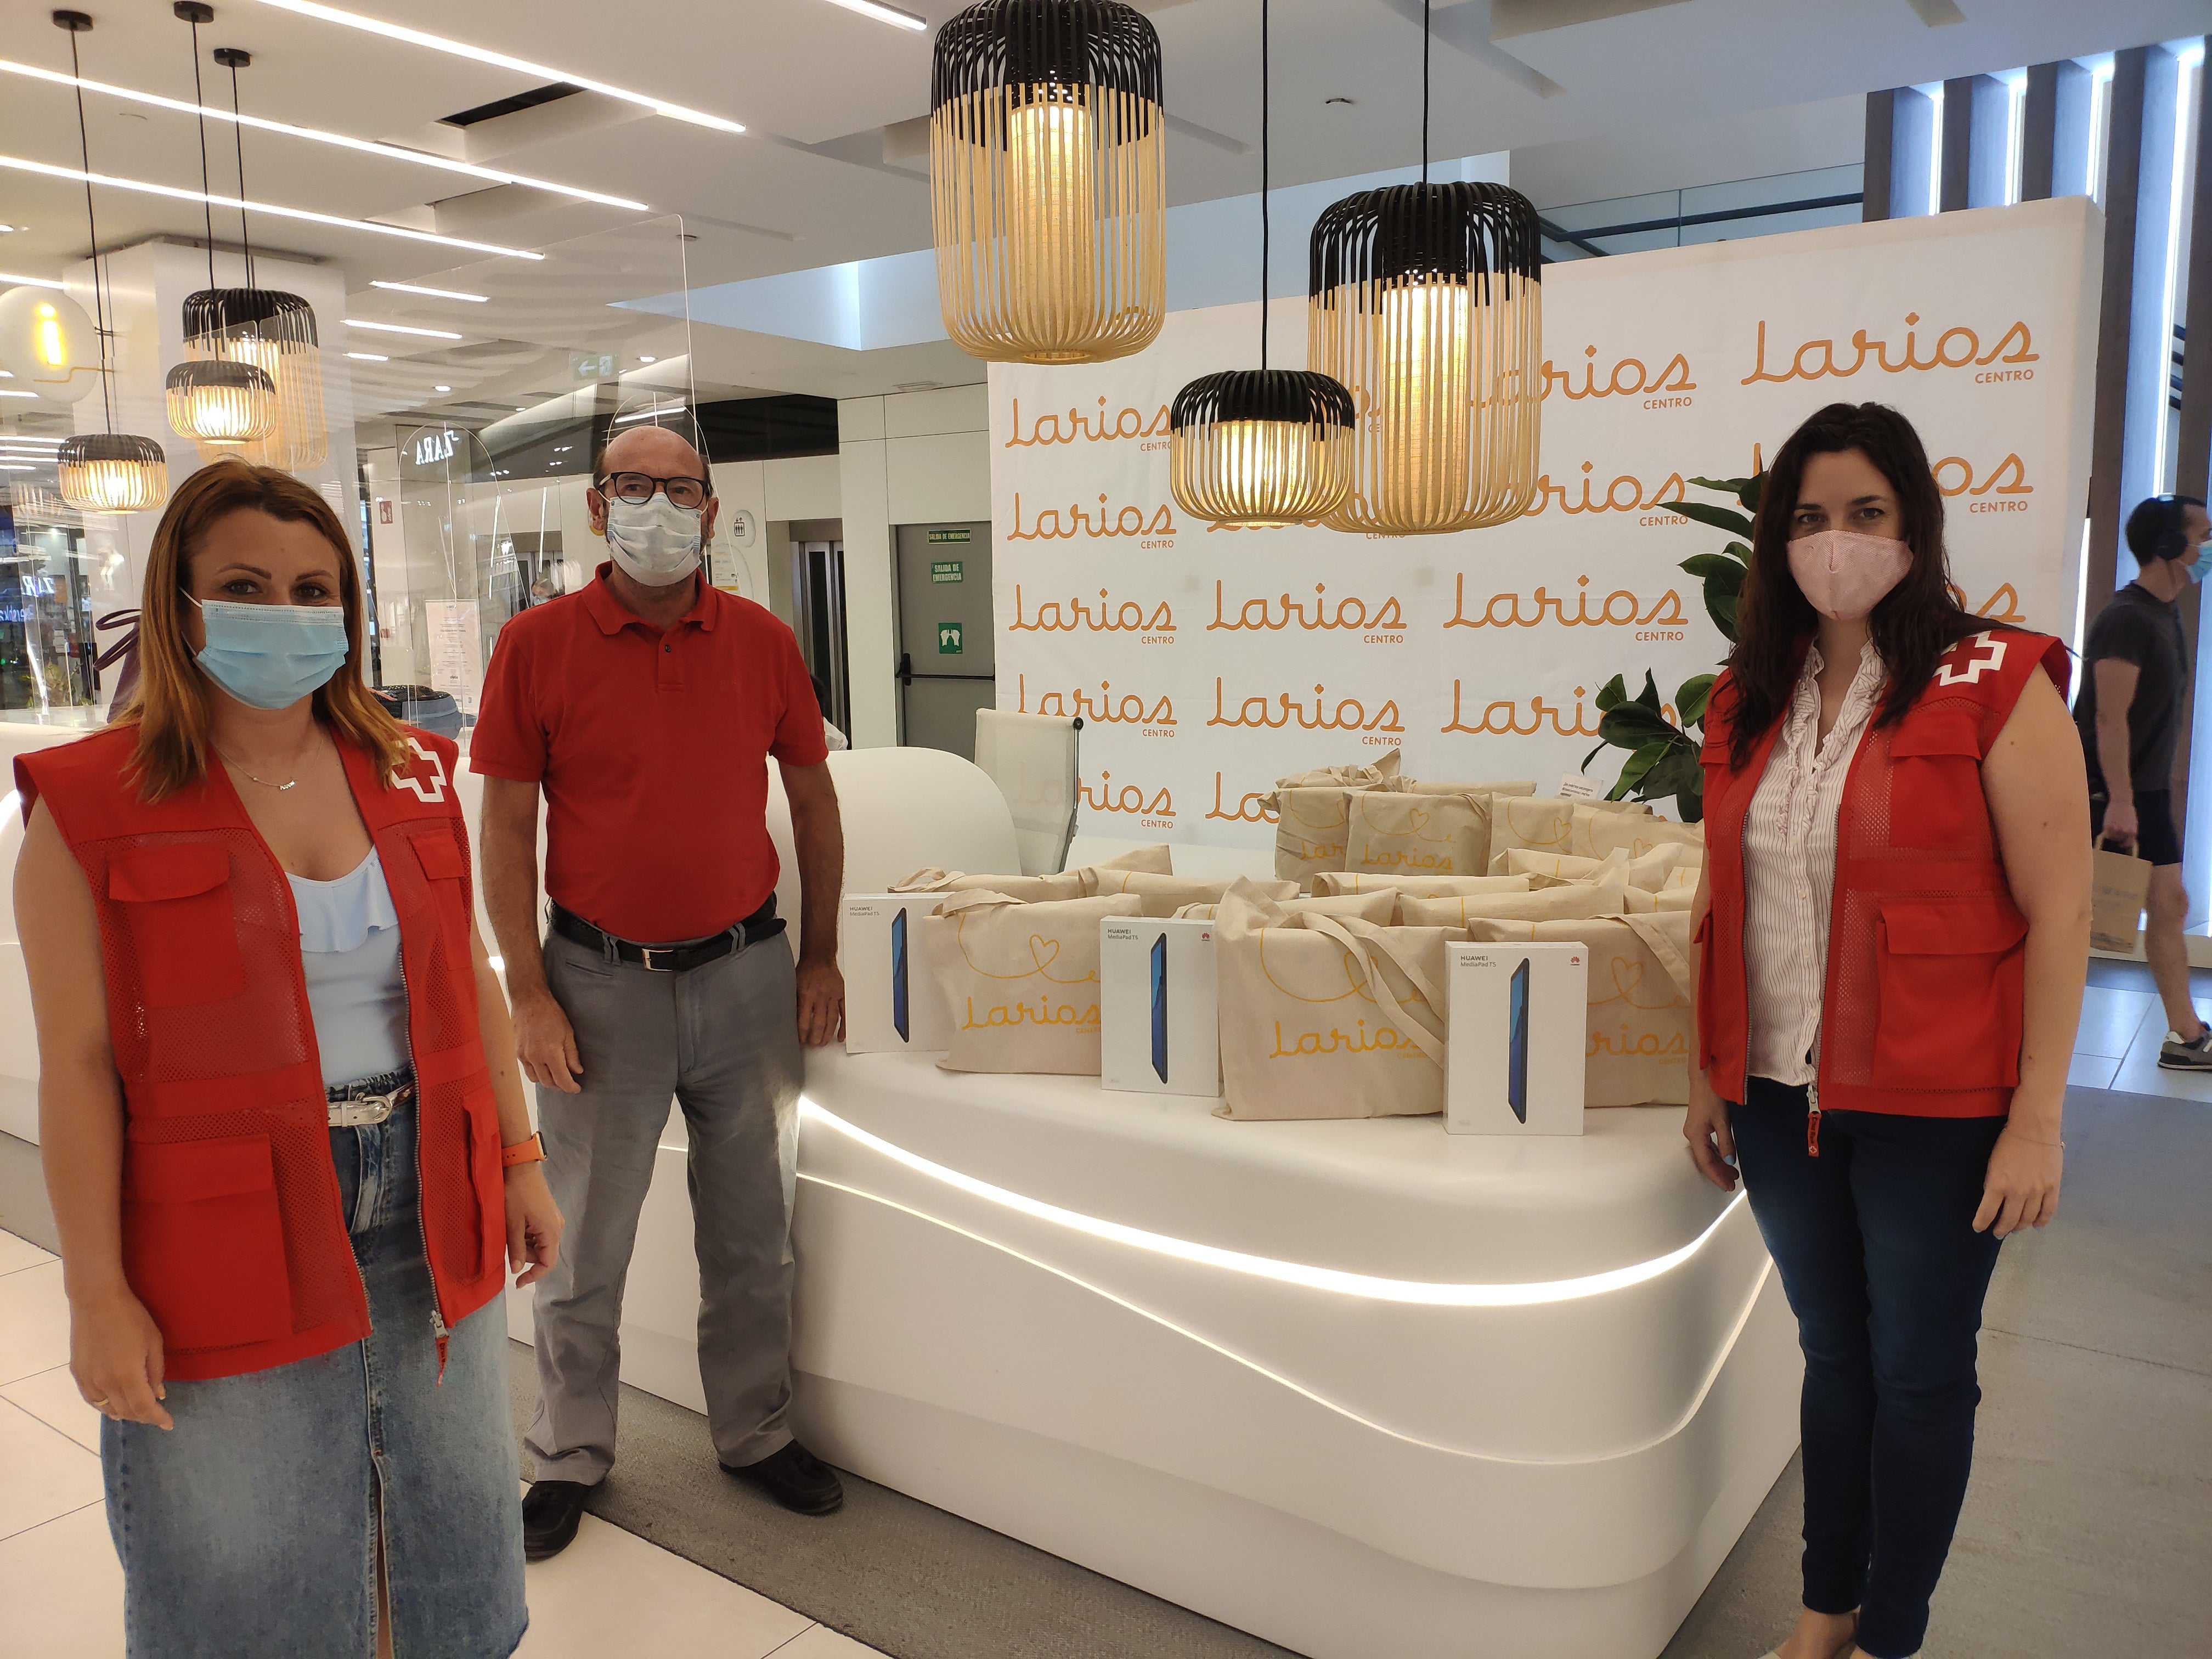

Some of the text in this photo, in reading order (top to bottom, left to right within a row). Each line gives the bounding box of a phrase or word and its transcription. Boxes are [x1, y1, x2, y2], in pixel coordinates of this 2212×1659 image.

[1741, 312, 2039, 386] Larios
[1541, 342, 1697, 402] rios
[1975, 369, 2034, 383] CENTRO
[1643, 397, 1692, 410] CENTRO
[1522, 461, 1689, 517] rios
[1970, 500, 2028, 513] CENTRO
[1007, 492, 1177, 541] Larios
[1639, 516, 1689, 527] CENTRO
[1141, 540, 1174, 549] CENTRO
[934, 563, 960, 573] SALIDA DE
[933, 573, 962, 582] EMERGENCIA
[1009, 584, 1177, 631] Larios
[1206, 580, 1407, 631] Larios
[1443, 572, 1689, 629] Larios
[1141, 636, 1175, 645] CENTRO
[1363, 635, 1403, 644] CENTRO
[1635, 631, 1684, 641] CENTRO
[1206, 677, 1406, 732] Larios
[1142, 729, 1175, 738] CENTRO
[1362, 736, 1402, 746] CENTRO
[1141, 819, 1173, 829] CENTRO
[1300, 840, 1345, 861] Lar
[1361, 844, 1453, 870] Larios
[961, 995, 1101, 1030] Larios
[1586, 1024, 1690, 1057] rios
